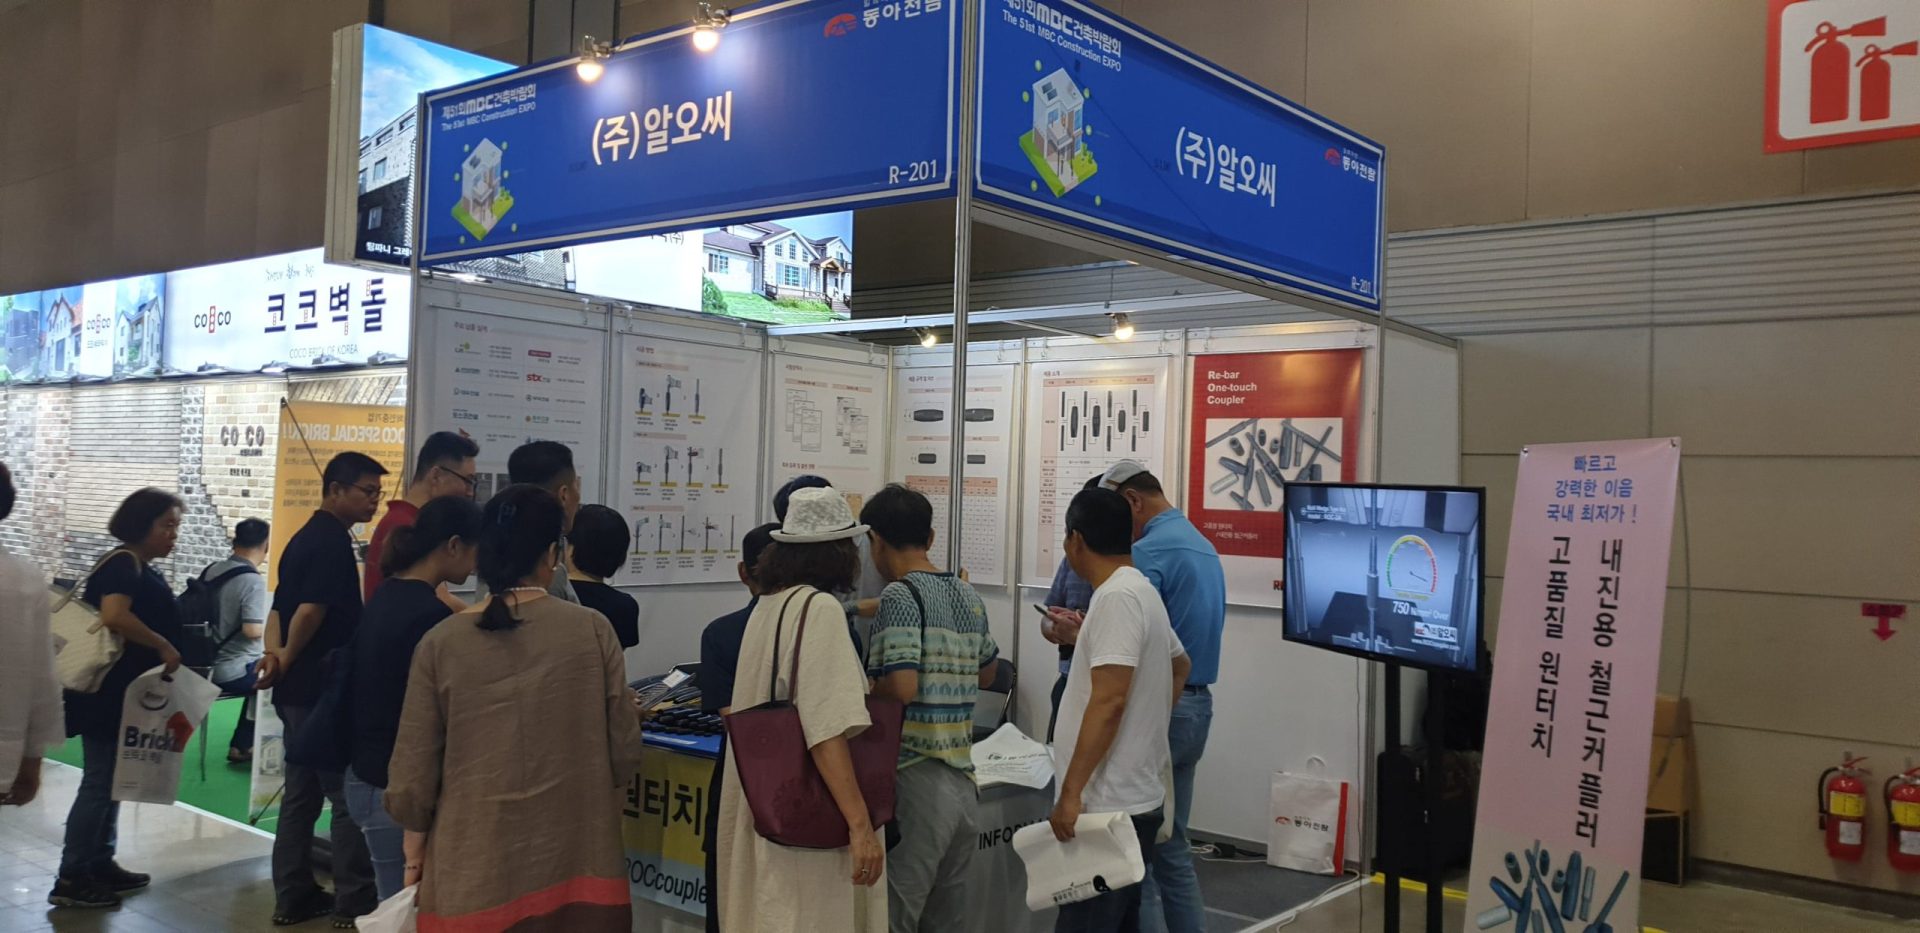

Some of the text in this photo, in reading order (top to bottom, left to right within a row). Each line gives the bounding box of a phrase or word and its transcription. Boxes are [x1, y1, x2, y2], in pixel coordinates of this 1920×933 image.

[1002, 9, 1121, 72] The 51st MBC Construction EXPO
[441, 122, 452, 131] The
[466, 115, 480, 126] MBC
[480, 107, 518, 122] Construction
[518, 101, 537, 114] EXPO
[592, 90, 733, 165] (주)알오씨
[889, 159, 937, 185] R-201
[1175, 126, 1277, 207] (주)알오씨
[1342, 155, 1377, 182] 동아전람
[264, 278, 386, 335] 코코벽돌
[289, 346, 308, 359] COCO
[337, 343, 359, 355] KOREA
[1208, 370, 1240, 380] Re-bar
[1207, 382, 1257, 392] One-touch
[1207, 395, 1245, 406] Coupler
[1573, 455, 1617, 473] 빠르고
[1555, 478, 1633, 498] 강력한 이음
[1546, 504, 1575, 522] 국내
[1580, 504, 1625, 523] 최저가
[1393, 601, 1409, 615] 750
[1530, 536, 1571, 758] 고품질 원터치
[1575, 538, 1623, 848] 내진용 철근커플러
[1294, 819, 1328, 832] 동아전람
